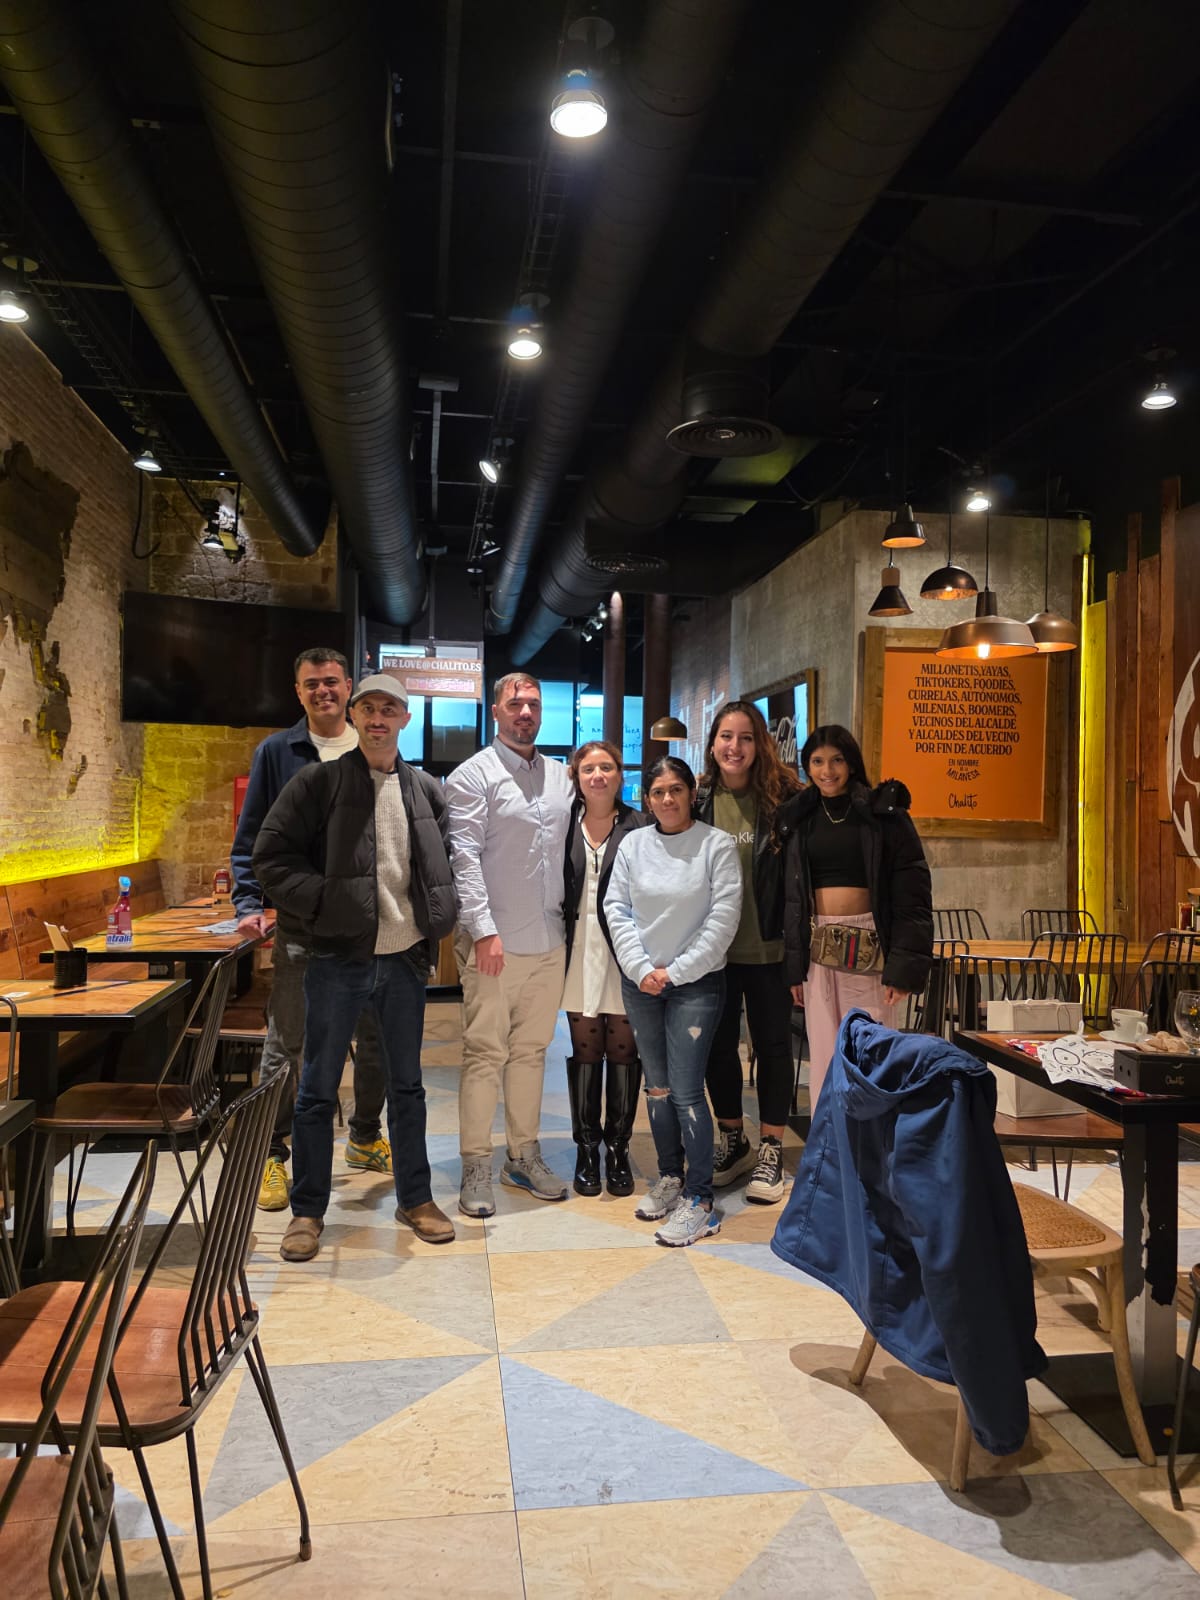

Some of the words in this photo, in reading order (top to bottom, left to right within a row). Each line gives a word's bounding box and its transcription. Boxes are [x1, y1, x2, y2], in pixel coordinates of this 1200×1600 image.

[383, 659, 398, 668] WE
[399, 660, 421, 669] LOVE
[921, 663, 980, 677] MILLONETIS,
[981, 666, 1011, 677] YAYAS,
[915, 676, 972, 690] TIKTOKERS,
[973, 678, 1016, 692] FOODIES,
[908, 689, 960, 703] CURRELAS,
[913, 702, 967, 716] MILENIALS,
[968, 704, 1017, 717] BOOMERS,
[912, 716, 954, 728] VECINOS
[955, 717, 975, 728] DEL
[974, 718, 1017, 730] ALCALDE
[908, 728, 915, 740] Y
[917, 729, 964, 741] ALCALDES
[966, 730, 985, 742] DEL
[985, 731, 1020, 743] VECINO
[915, 742, 935, 753] POR
[937, 742, 953, 754] FIN
[954, 743, 967, 755] DE
[968, 743, 1013, 756] ACUERDO
[738, 831, 755, 844] Kle
